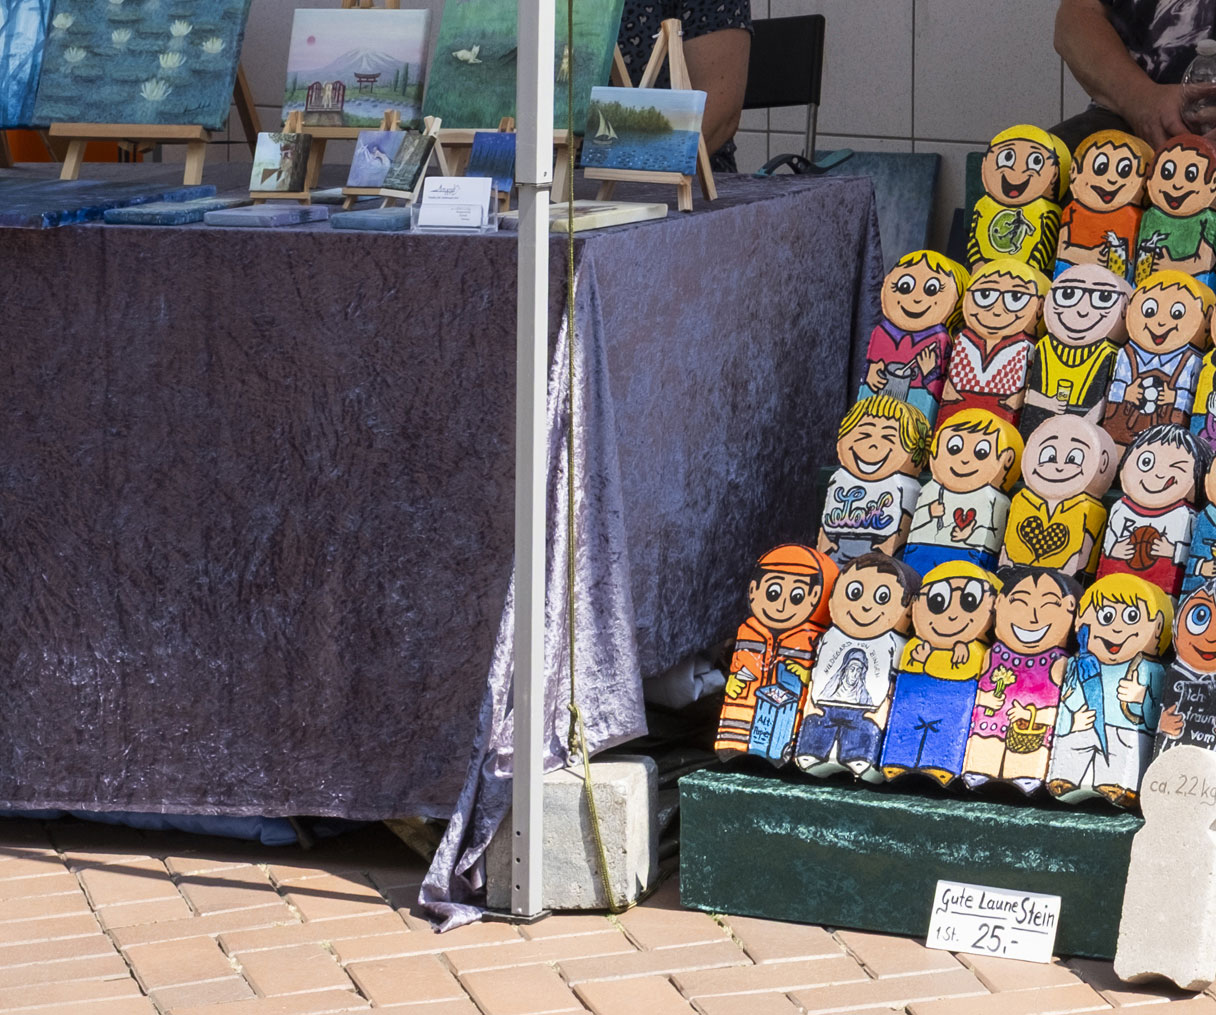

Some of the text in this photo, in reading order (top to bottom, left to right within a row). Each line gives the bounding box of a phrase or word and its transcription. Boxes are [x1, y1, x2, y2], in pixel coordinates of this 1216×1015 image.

[1186, 686, 1207, 703] Ich
[1191, 730, 1216, 744] vom
[1149, 779, 1171, 796] ca.
[936, 887, 1055, 928] Gute Laune Stein
[943, 926, 959, 943] St.
[971, 923, 1019, 954] 25,-
